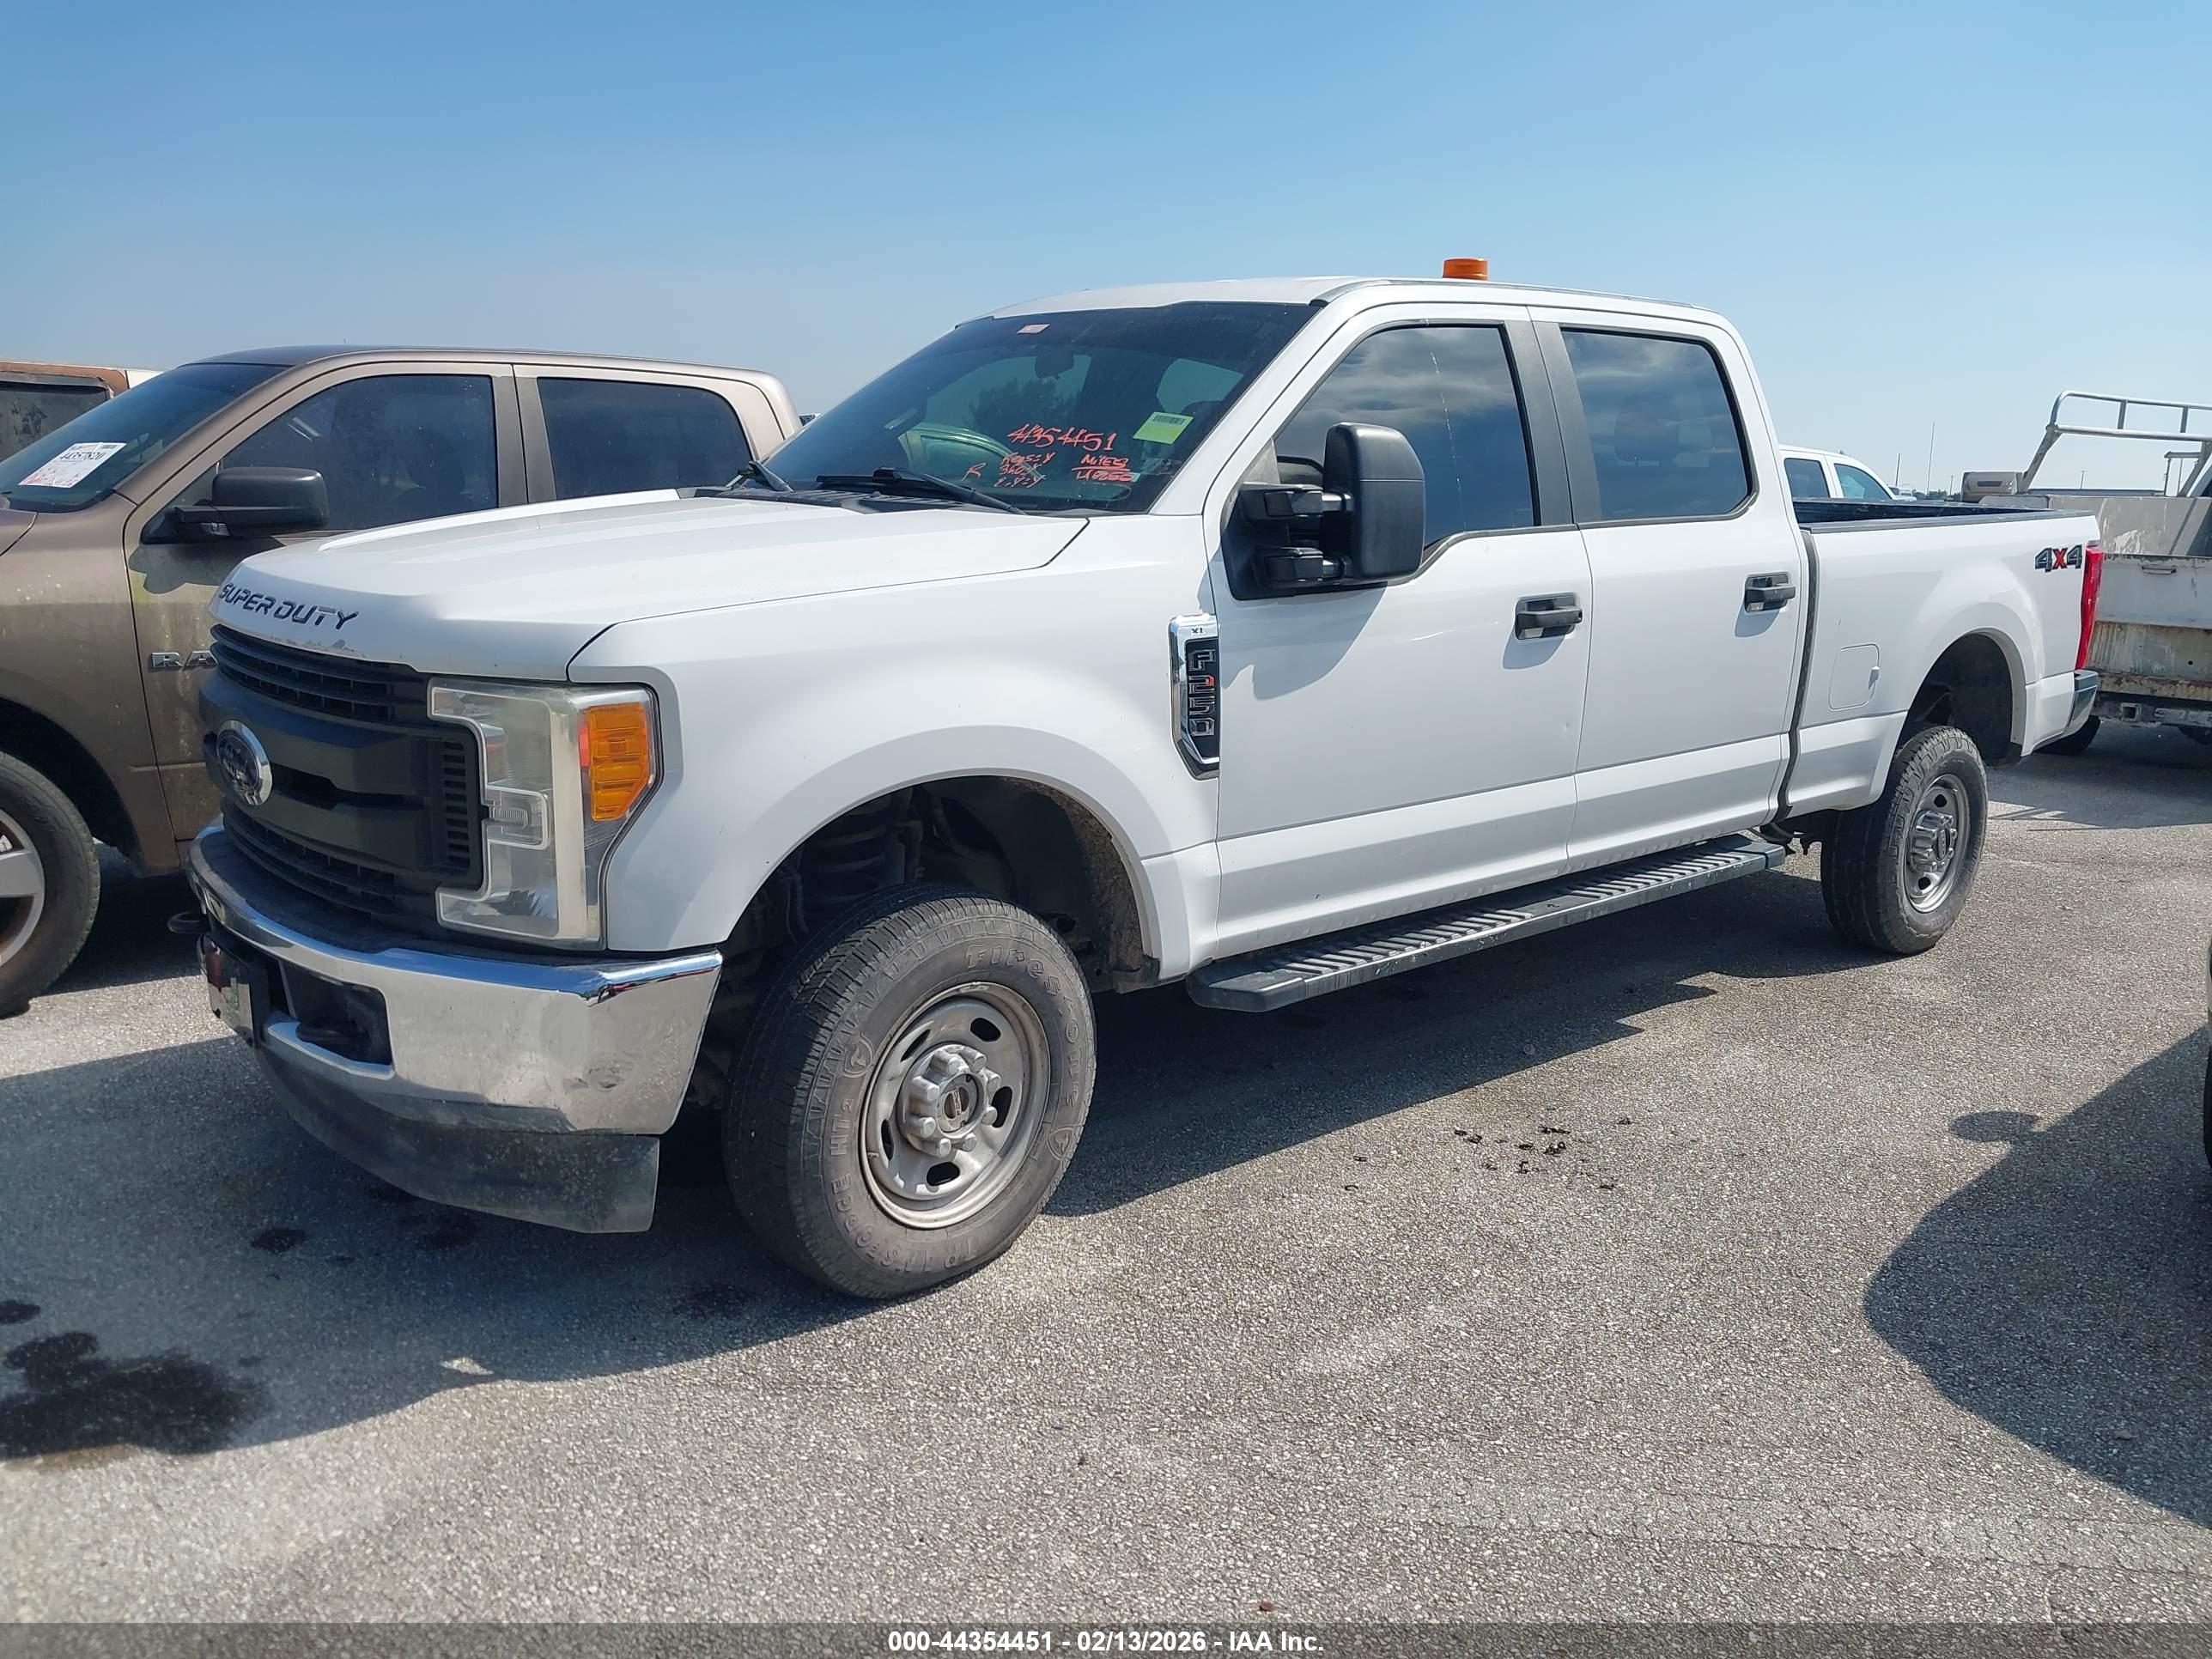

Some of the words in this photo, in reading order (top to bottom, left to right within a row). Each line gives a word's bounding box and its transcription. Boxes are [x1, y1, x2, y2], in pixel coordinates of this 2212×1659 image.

[219, 583, 276, 615] SUPER
[273, 600, 359, 630] DUTY
[151, 650, 219, 669] RA
